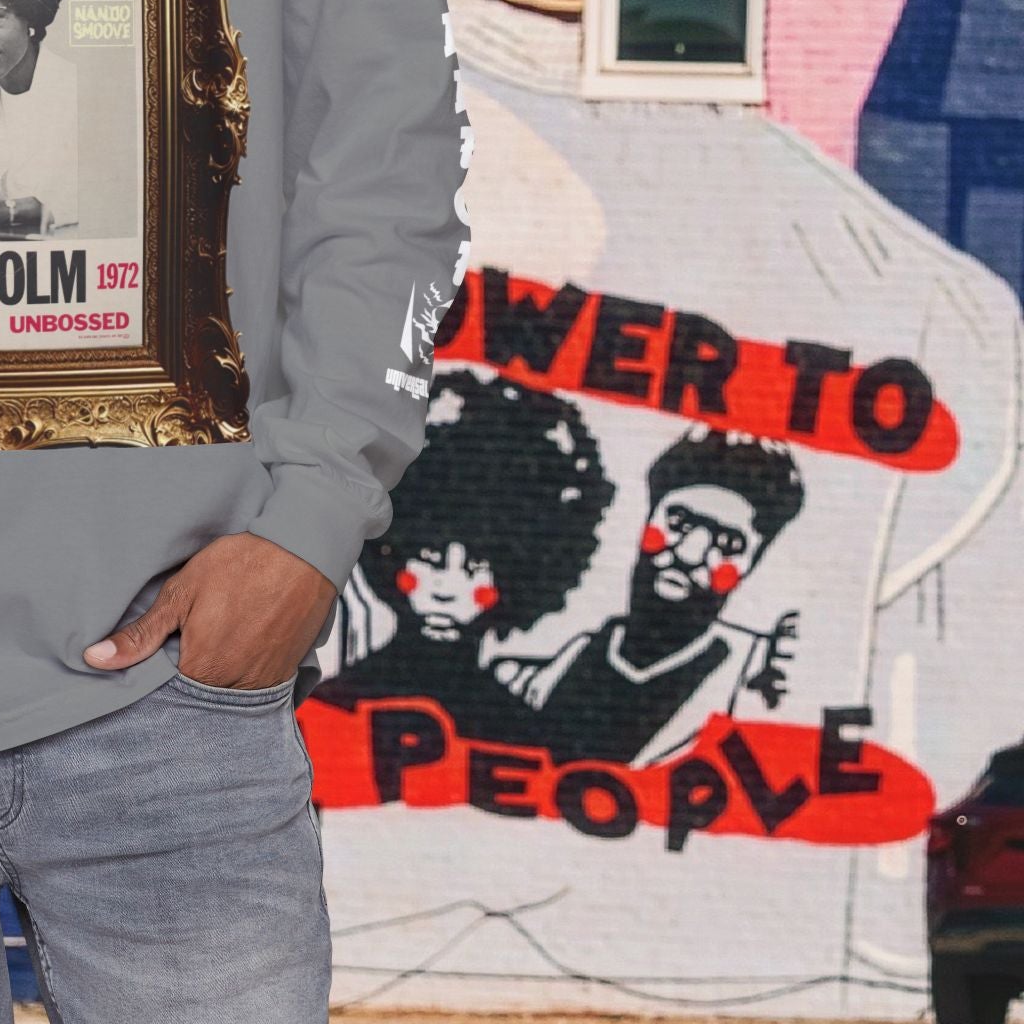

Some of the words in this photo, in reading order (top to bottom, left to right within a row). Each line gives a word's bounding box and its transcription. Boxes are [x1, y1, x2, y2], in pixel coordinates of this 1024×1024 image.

[97, 262, 139, 290] 1972
[9, 312, 130, 333] UNBOSSED
[783, 339, 936, 455] TO
[370, 707, 883, 854] PEOPLE
